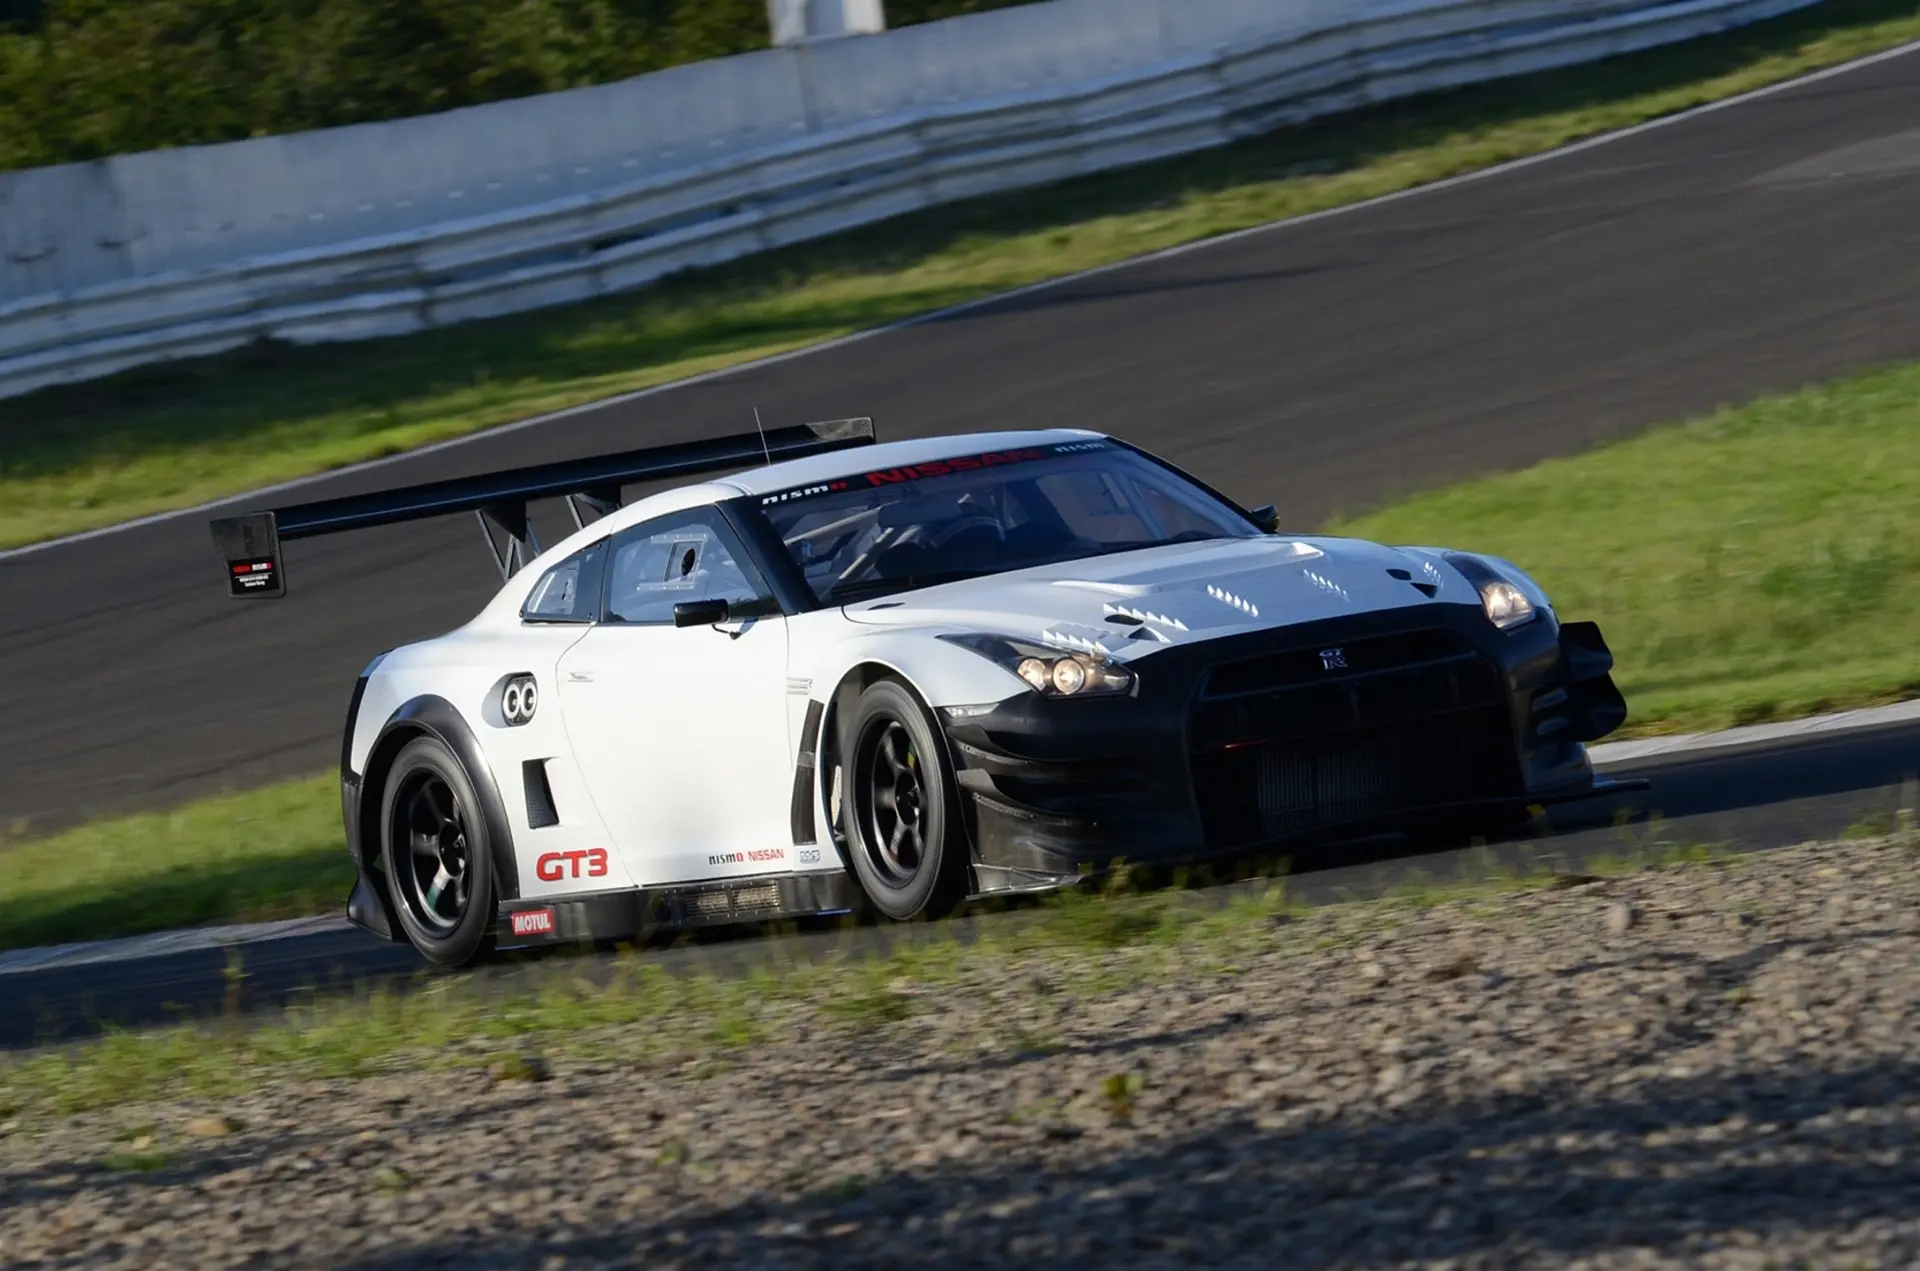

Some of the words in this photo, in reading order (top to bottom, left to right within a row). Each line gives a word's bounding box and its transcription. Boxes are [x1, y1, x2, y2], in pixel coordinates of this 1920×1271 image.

[864, 448, 1044, 487] NISSAN
[536, 848, 608, 881] GT3
[747, 848, 784, 862] NISSAN
[514, 912, 551, 932] MOTUL
